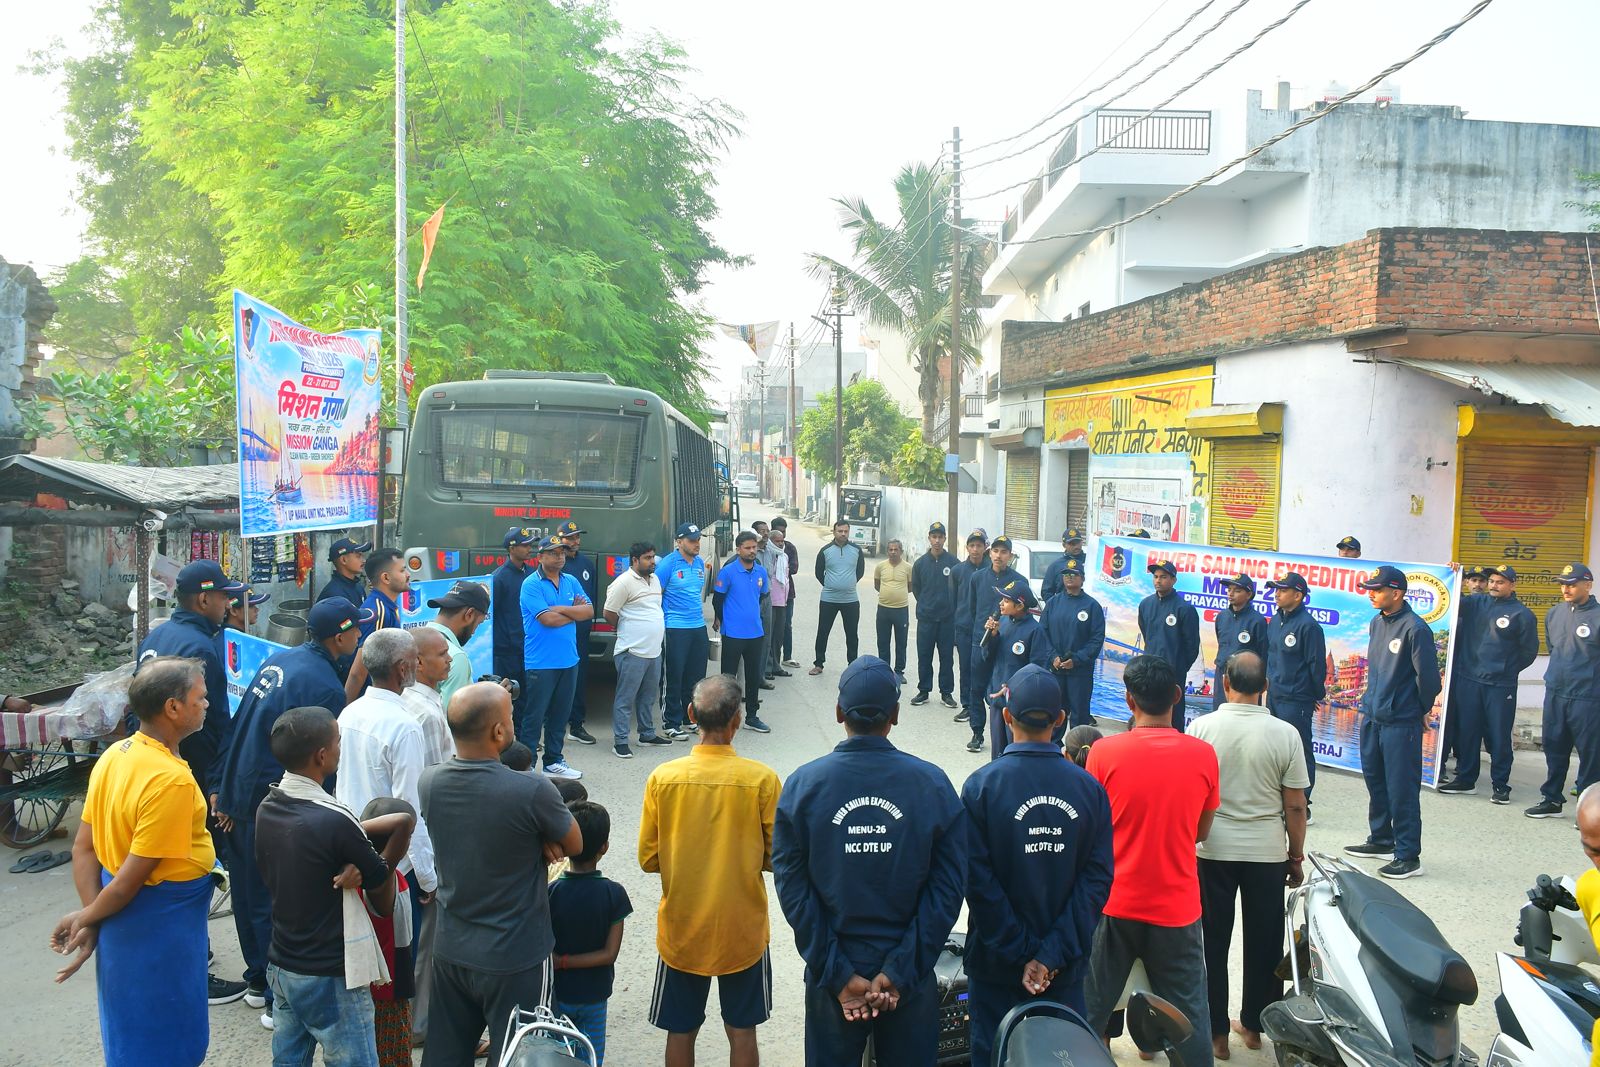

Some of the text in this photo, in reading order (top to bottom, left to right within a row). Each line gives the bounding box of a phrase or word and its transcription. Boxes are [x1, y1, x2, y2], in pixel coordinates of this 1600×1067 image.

[278, 379, 345, 420] मिशन गंगा
[286, 434, 338, 450] MISSION GANGA
[1124, 419, 1158, 454] पनीर
[494, 507, 571, 518] MINISTRY OF DEFENCE
[482, 555, 494, 566] UP
[1147, 550, 1371, 596] RIVER SAILING EXPEDITIO
[1424, 576, 1446, 595] GANGA
[1184, 593, 1230, 610] PRAYAG
[1252, 602, 1268, 615] TO
[832, 796, 903, 825] RIVER SAILING EXPEDITION
[1014, 796, 1079, 821] RIVER SAILING EXPEDITION
[848, 825, 886, 834] MENU-26
[1029, 827, 1062, 835] MENU-26
[845, 842, 892, 853] NCC DTE UP
[1025, 842, 1065, 853] NCC DTE UP
